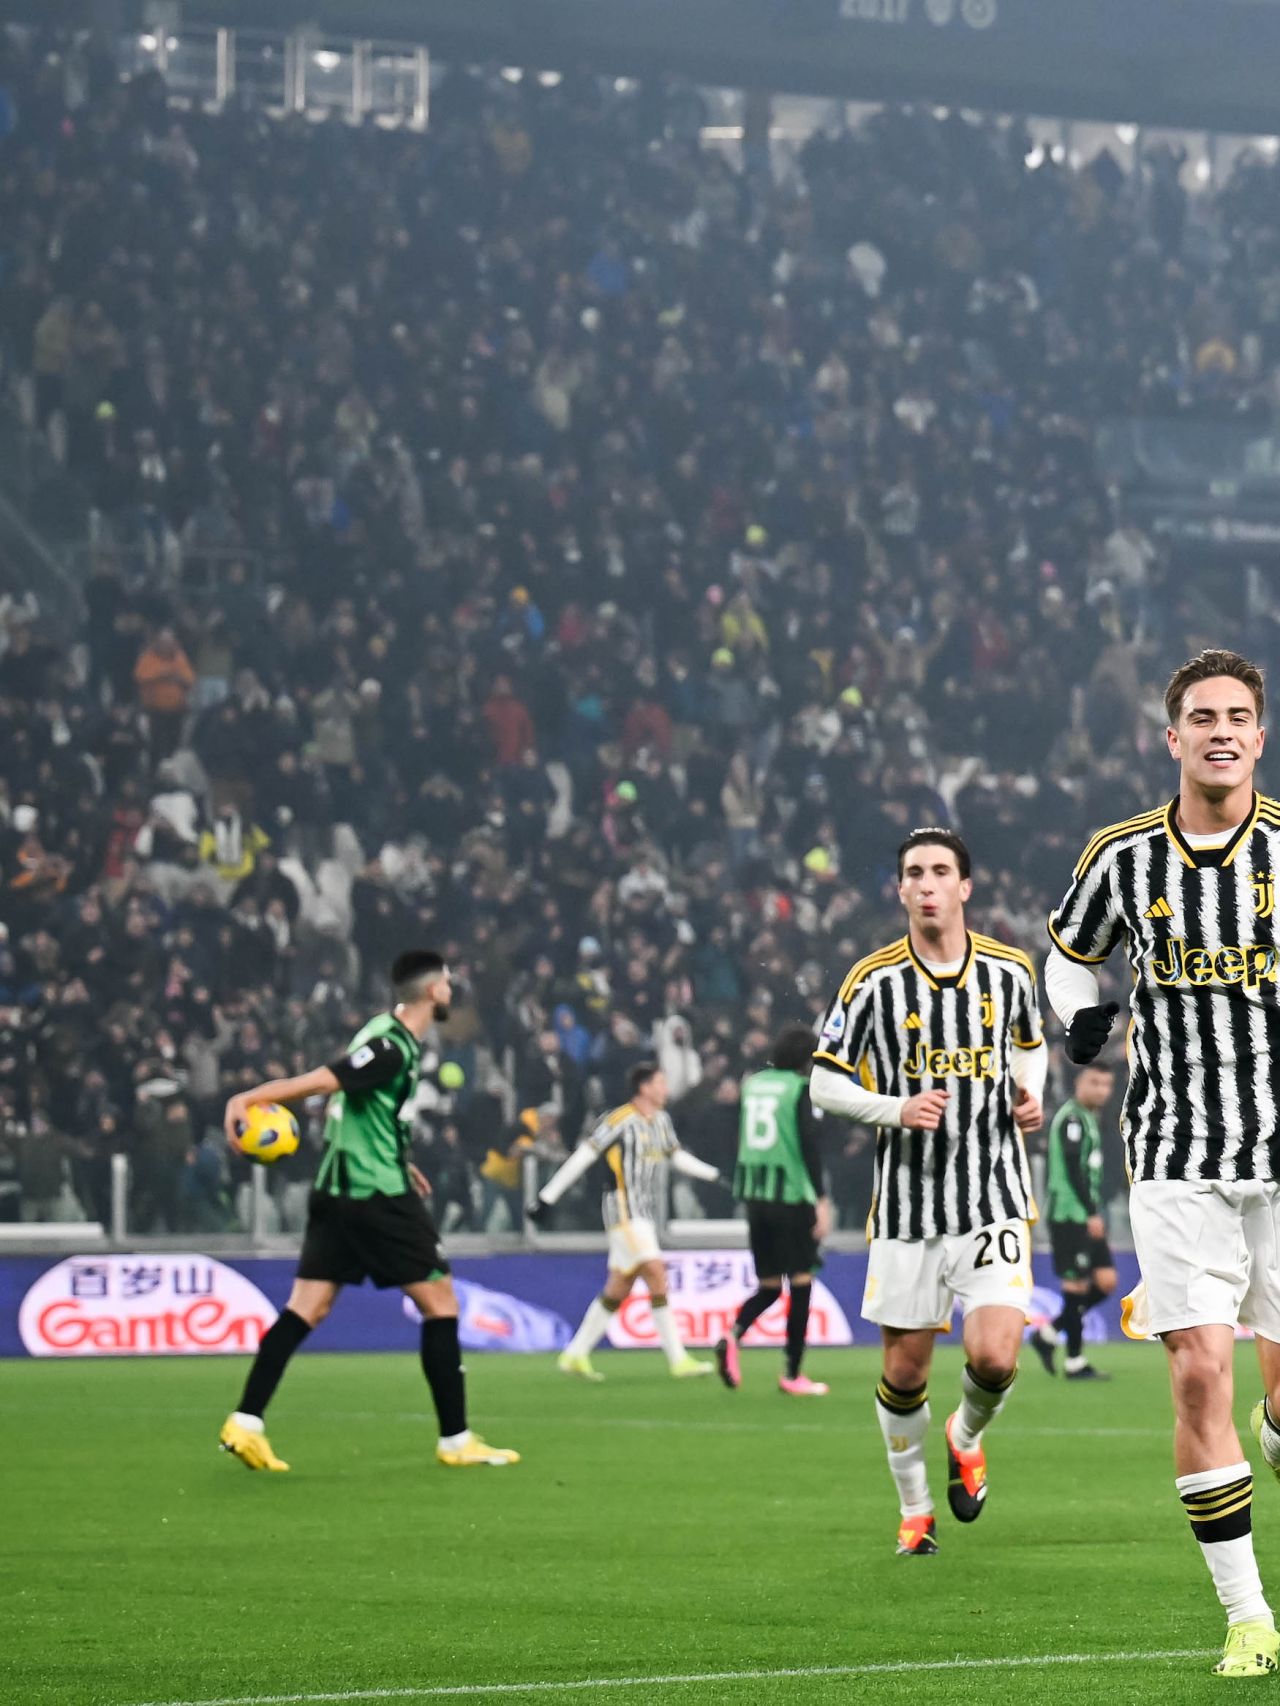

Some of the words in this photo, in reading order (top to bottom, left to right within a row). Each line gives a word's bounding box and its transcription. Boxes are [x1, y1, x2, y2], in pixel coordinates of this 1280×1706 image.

[1151, 939, 1279, 988] Jeep
[903, 1042, 997, 1081] Jeep
[974, 1229, 1021, 1269] 20
[71, 1263, 214, 1297] 百岁山
